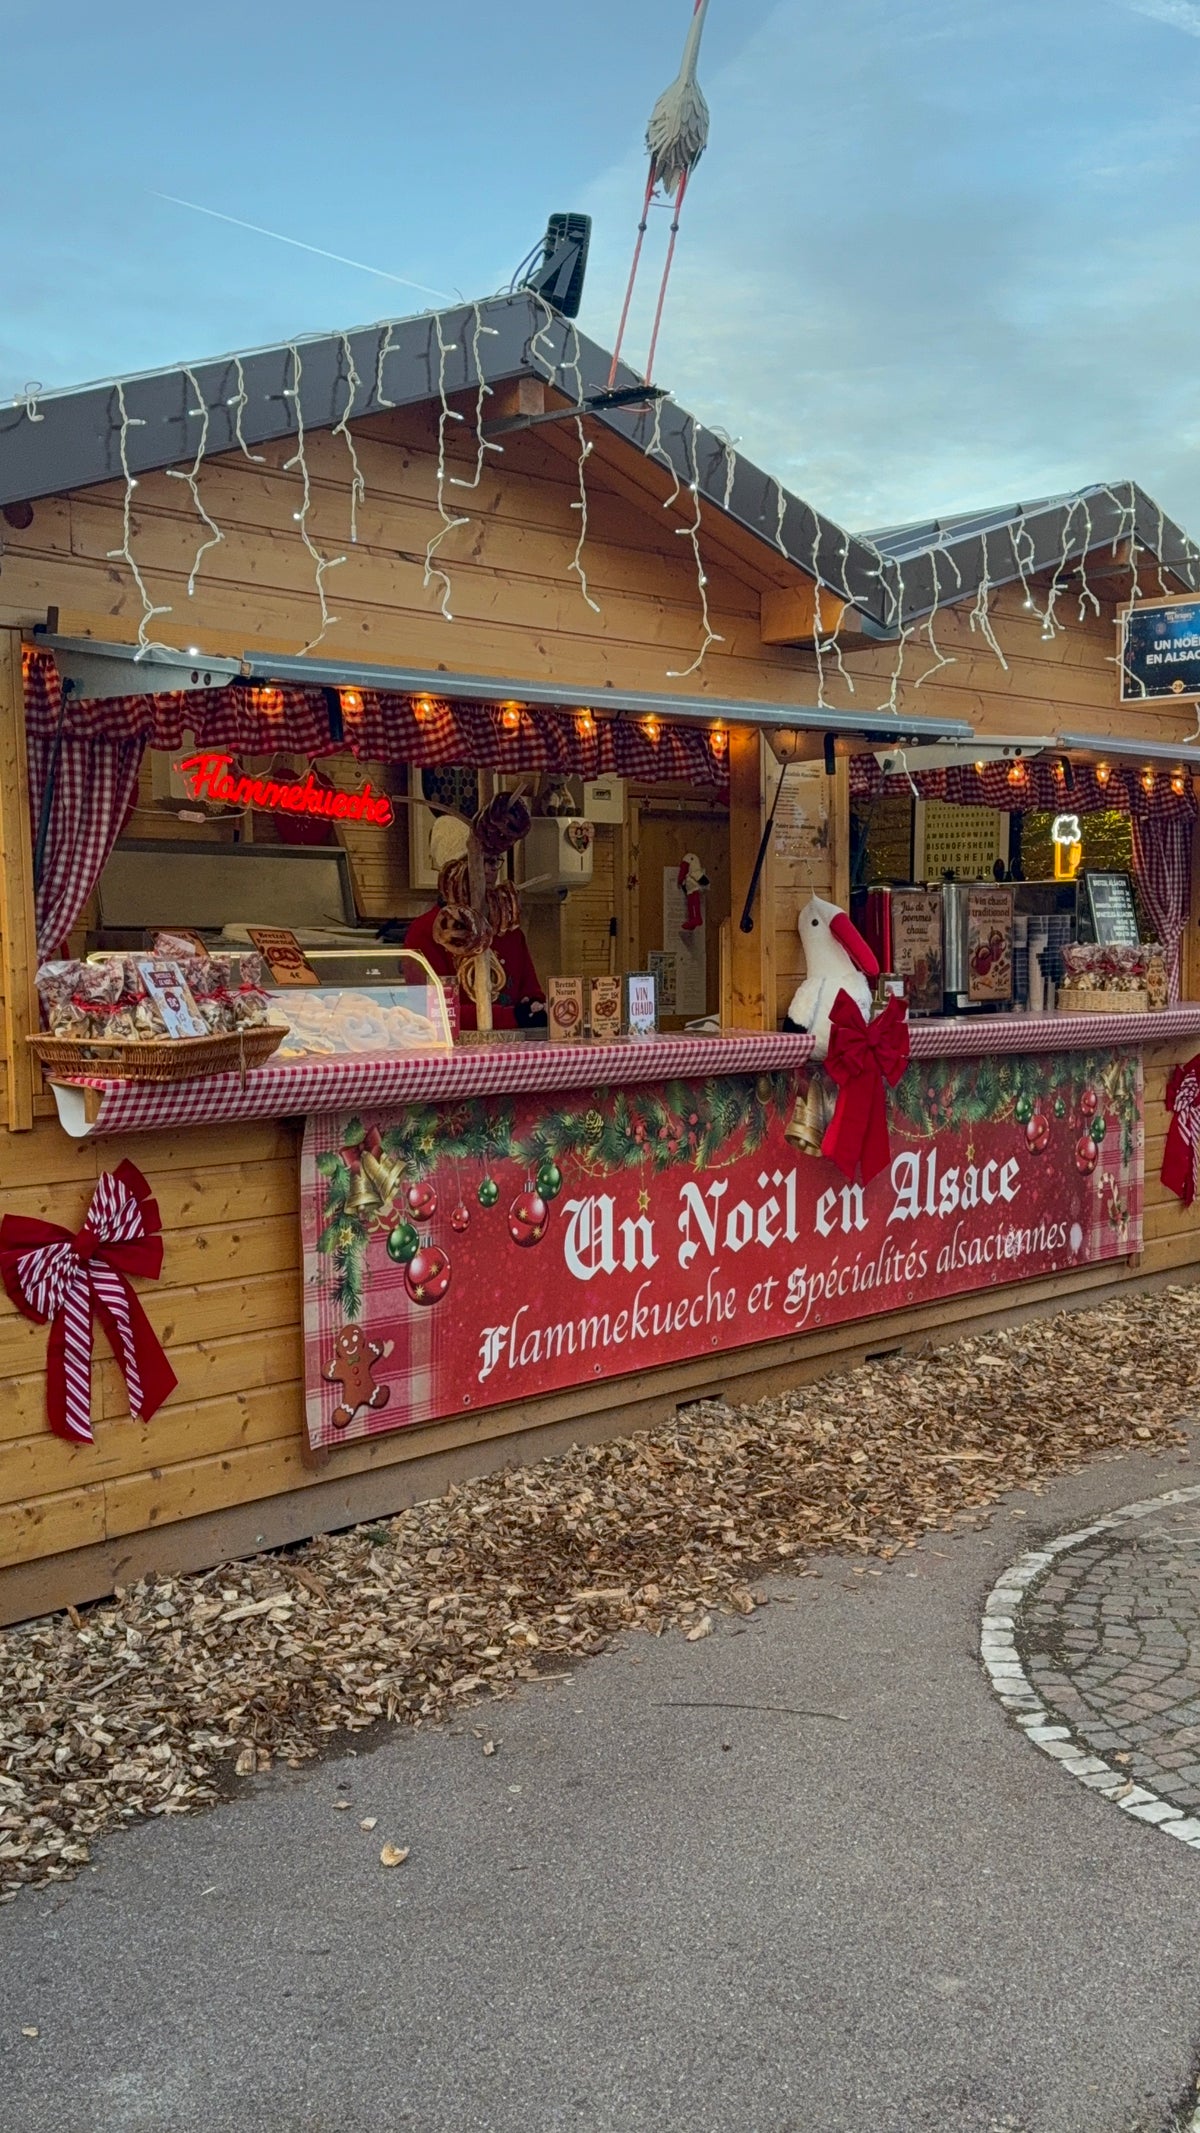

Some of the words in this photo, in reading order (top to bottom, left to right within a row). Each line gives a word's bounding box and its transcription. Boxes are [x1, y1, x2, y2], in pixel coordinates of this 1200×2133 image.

[1154, 640, 1171, 650] UN
[1174, 634, 1200, 649] NOË
[1146, 654, 1163, 664] EN
[180, 754, 392, 824] Flammekueche
[926, 842, 995, 850] BISCHOFFSHEIM
[926, 853, 994, 862] EGUISHEIM
[975, 896, 986, 905] Vin
[987, 896, 1008, 906] chaud
[916, 902, 925, 911] de
[902, 915, 932, 925] pommes
[902, 948, 912, 959] 3€
[290, 971, 302, 979] 4€
[555, 988, 576, 996] Nature
[635, 986, 648, 1001] VIN
[631, 1001, 653, 1016] CHAUD
[560, 1193, 660, 1281] Un
[678, 1167, 801, 1270] Noël
[813, 1183, 870, 1238] en
[886, 1147, 1022, 1227] Alsace
[478, 1266, 737, 1384] Flammekueche
[747, 1276, 781, 1314] et
[783, 1235, 929, 1328] Spécialités
[936, 1220, 1068, 1274] alsaciennes
